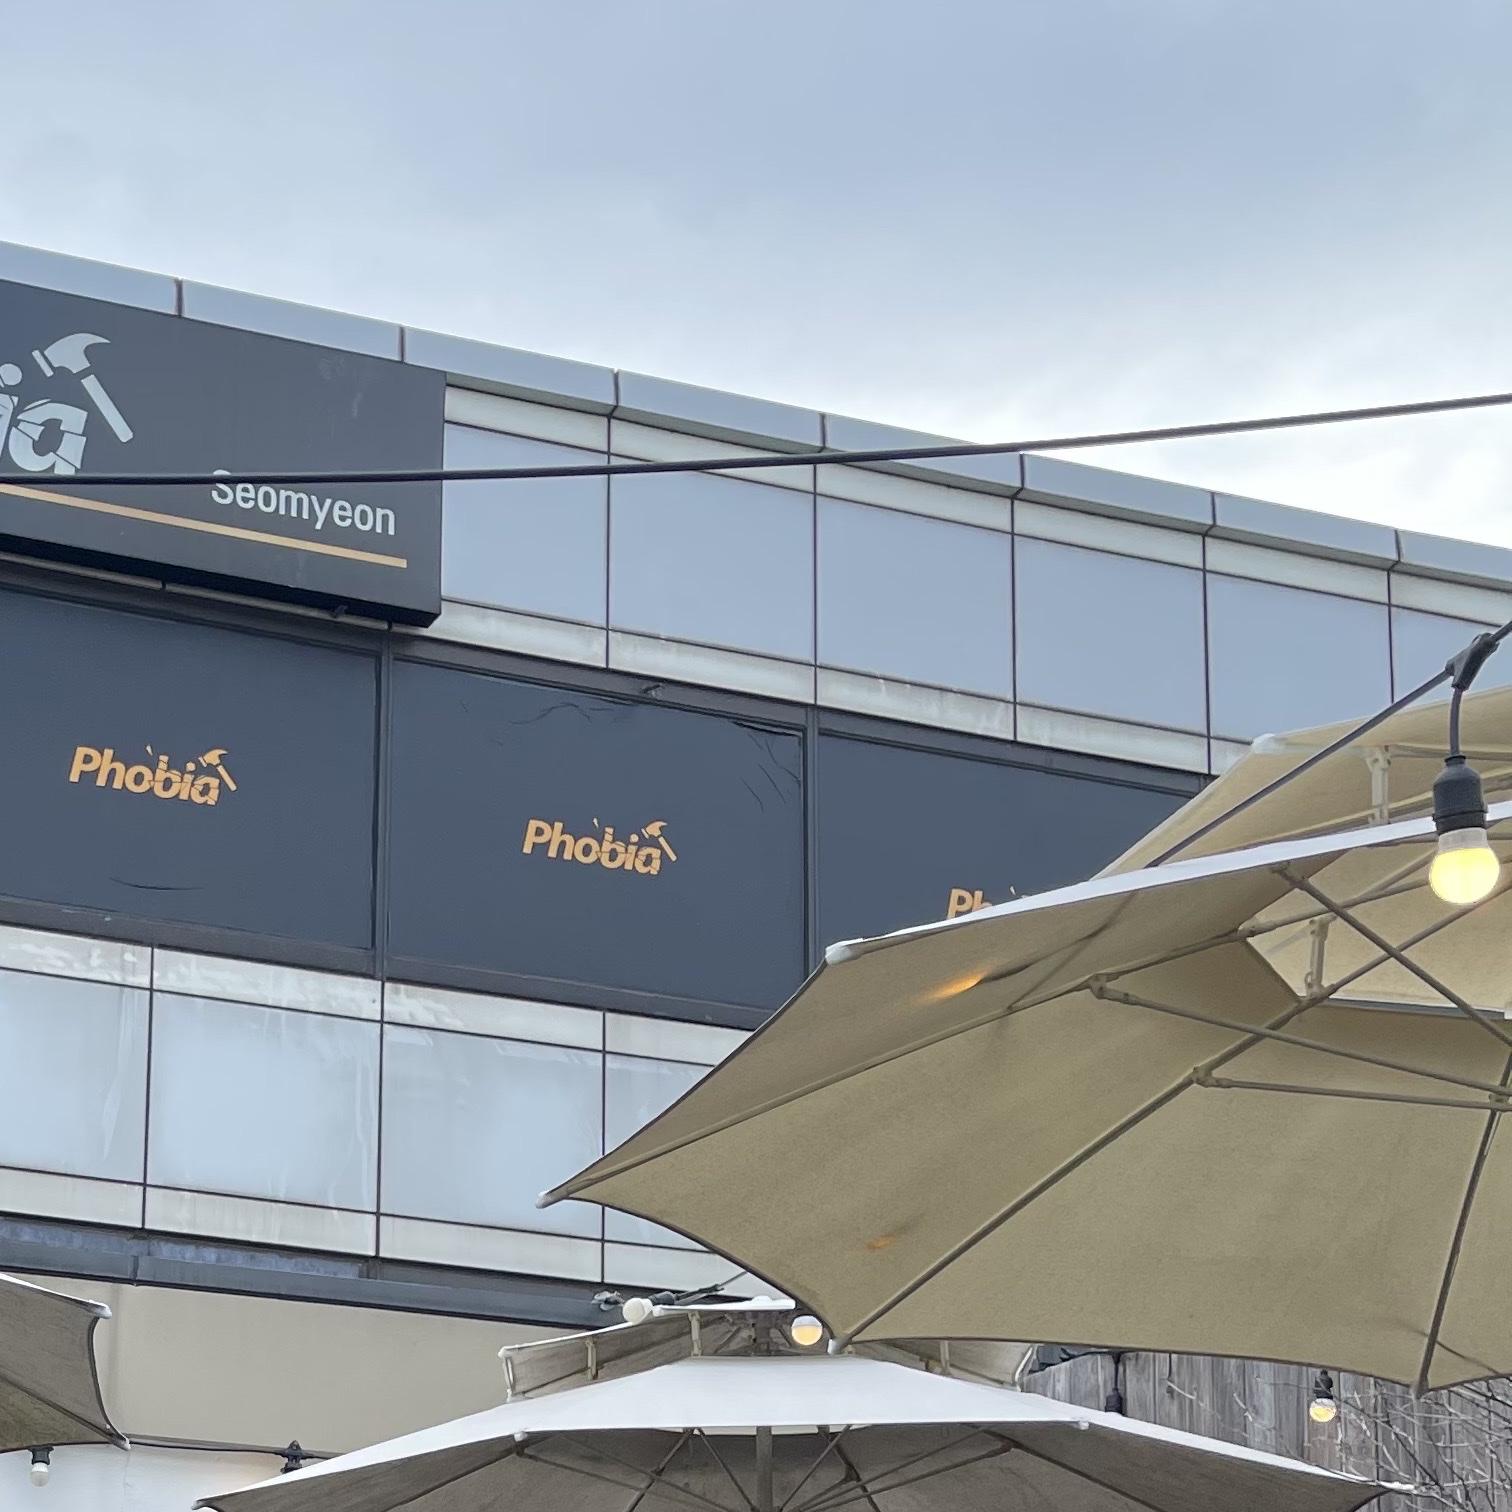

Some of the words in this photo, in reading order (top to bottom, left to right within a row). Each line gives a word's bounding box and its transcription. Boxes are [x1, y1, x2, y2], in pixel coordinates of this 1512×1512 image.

[211, 469, 396, 536] Seomyeon
[68, 744, 221, 806] Phobia
[522, 817, 662, 876] Phobia
